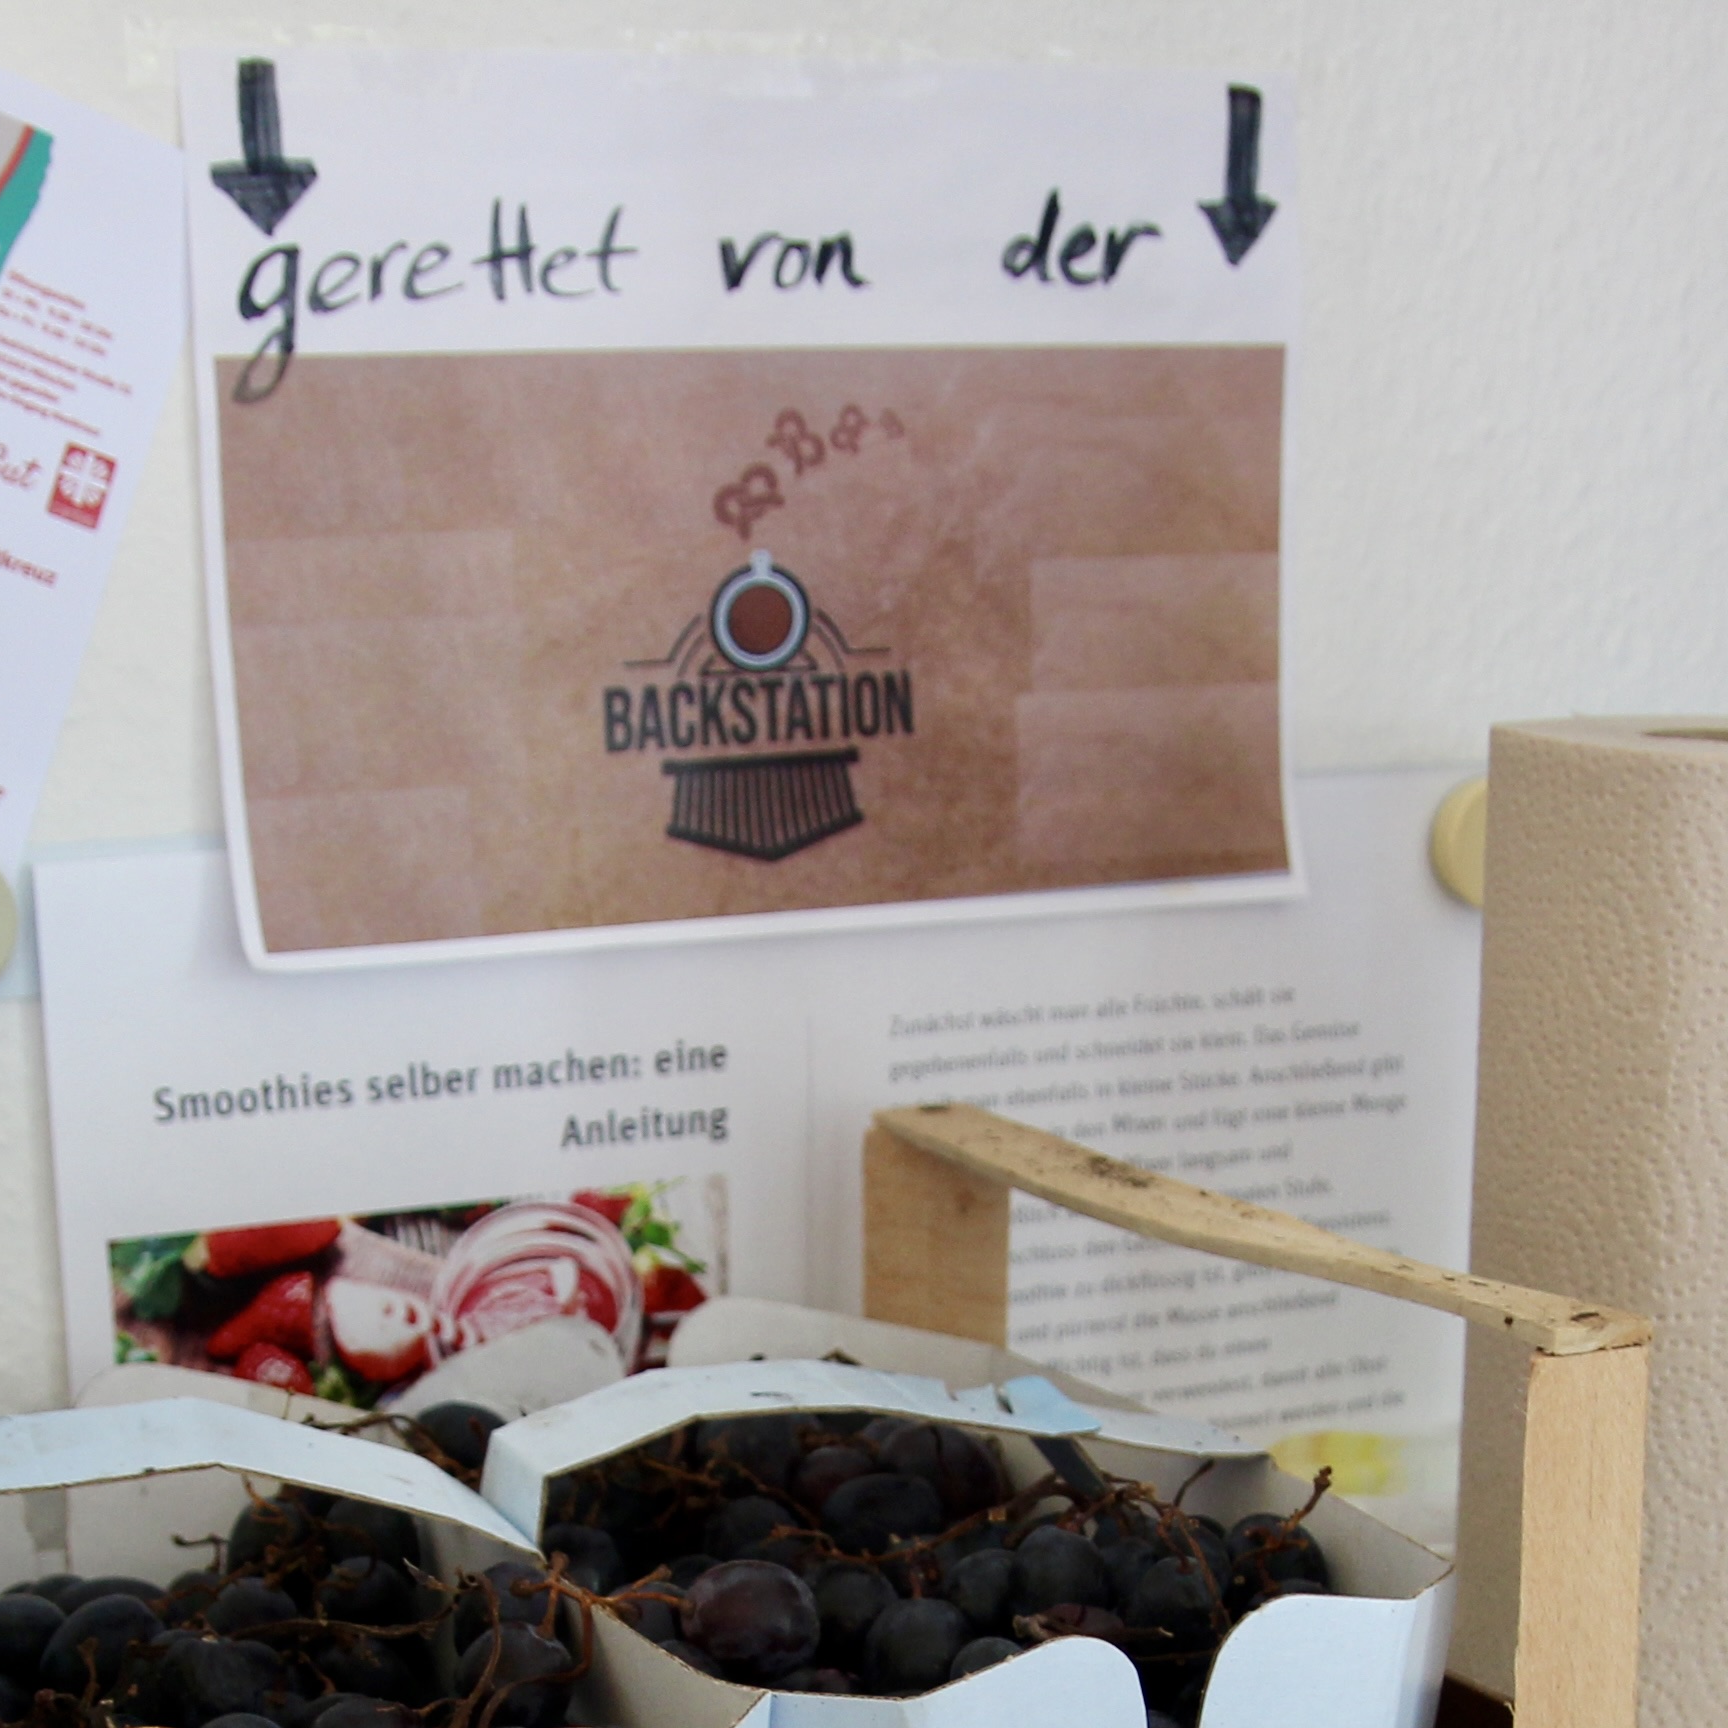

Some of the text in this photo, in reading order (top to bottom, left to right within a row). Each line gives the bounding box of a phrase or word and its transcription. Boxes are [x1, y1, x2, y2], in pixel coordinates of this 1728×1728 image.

[233, 197, 638, 403] gerettet
[718, 230, 870, 292] von
[1001, 190, 1161, 290] der
[603, 670, 915, 754] BACKSTATION
[155, 1039, 729, 1124] Smoothies selber machen: eine
[560, 1104, 730, 1149] Anleitung
